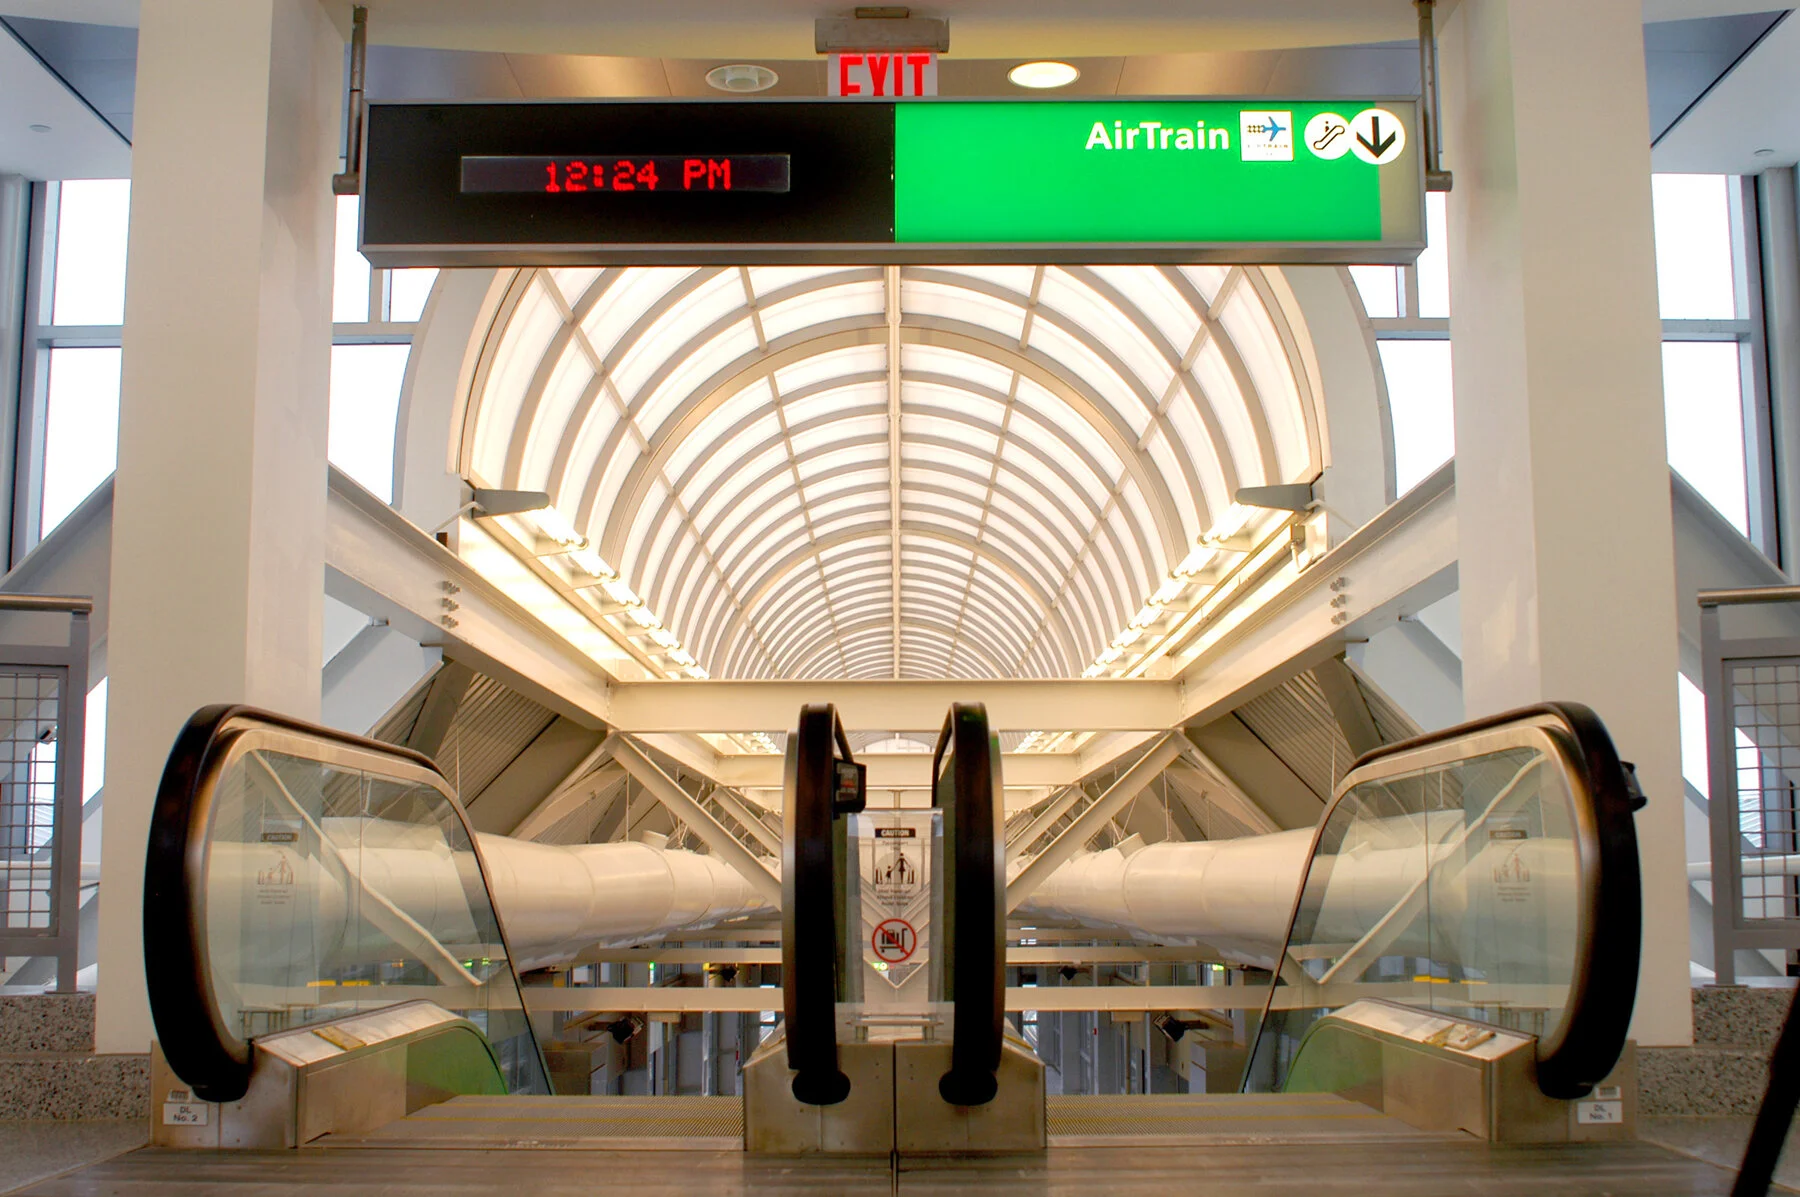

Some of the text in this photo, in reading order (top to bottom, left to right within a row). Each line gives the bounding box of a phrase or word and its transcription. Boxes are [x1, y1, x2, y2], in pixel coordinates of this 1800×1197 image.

[839, 53, 931, 96] EXIT
[1085, 120, 1230, 150] AirTrain
[545, 158, 732, 192] 12:24 PM
[880, 829, 910, 837] CAUTION
